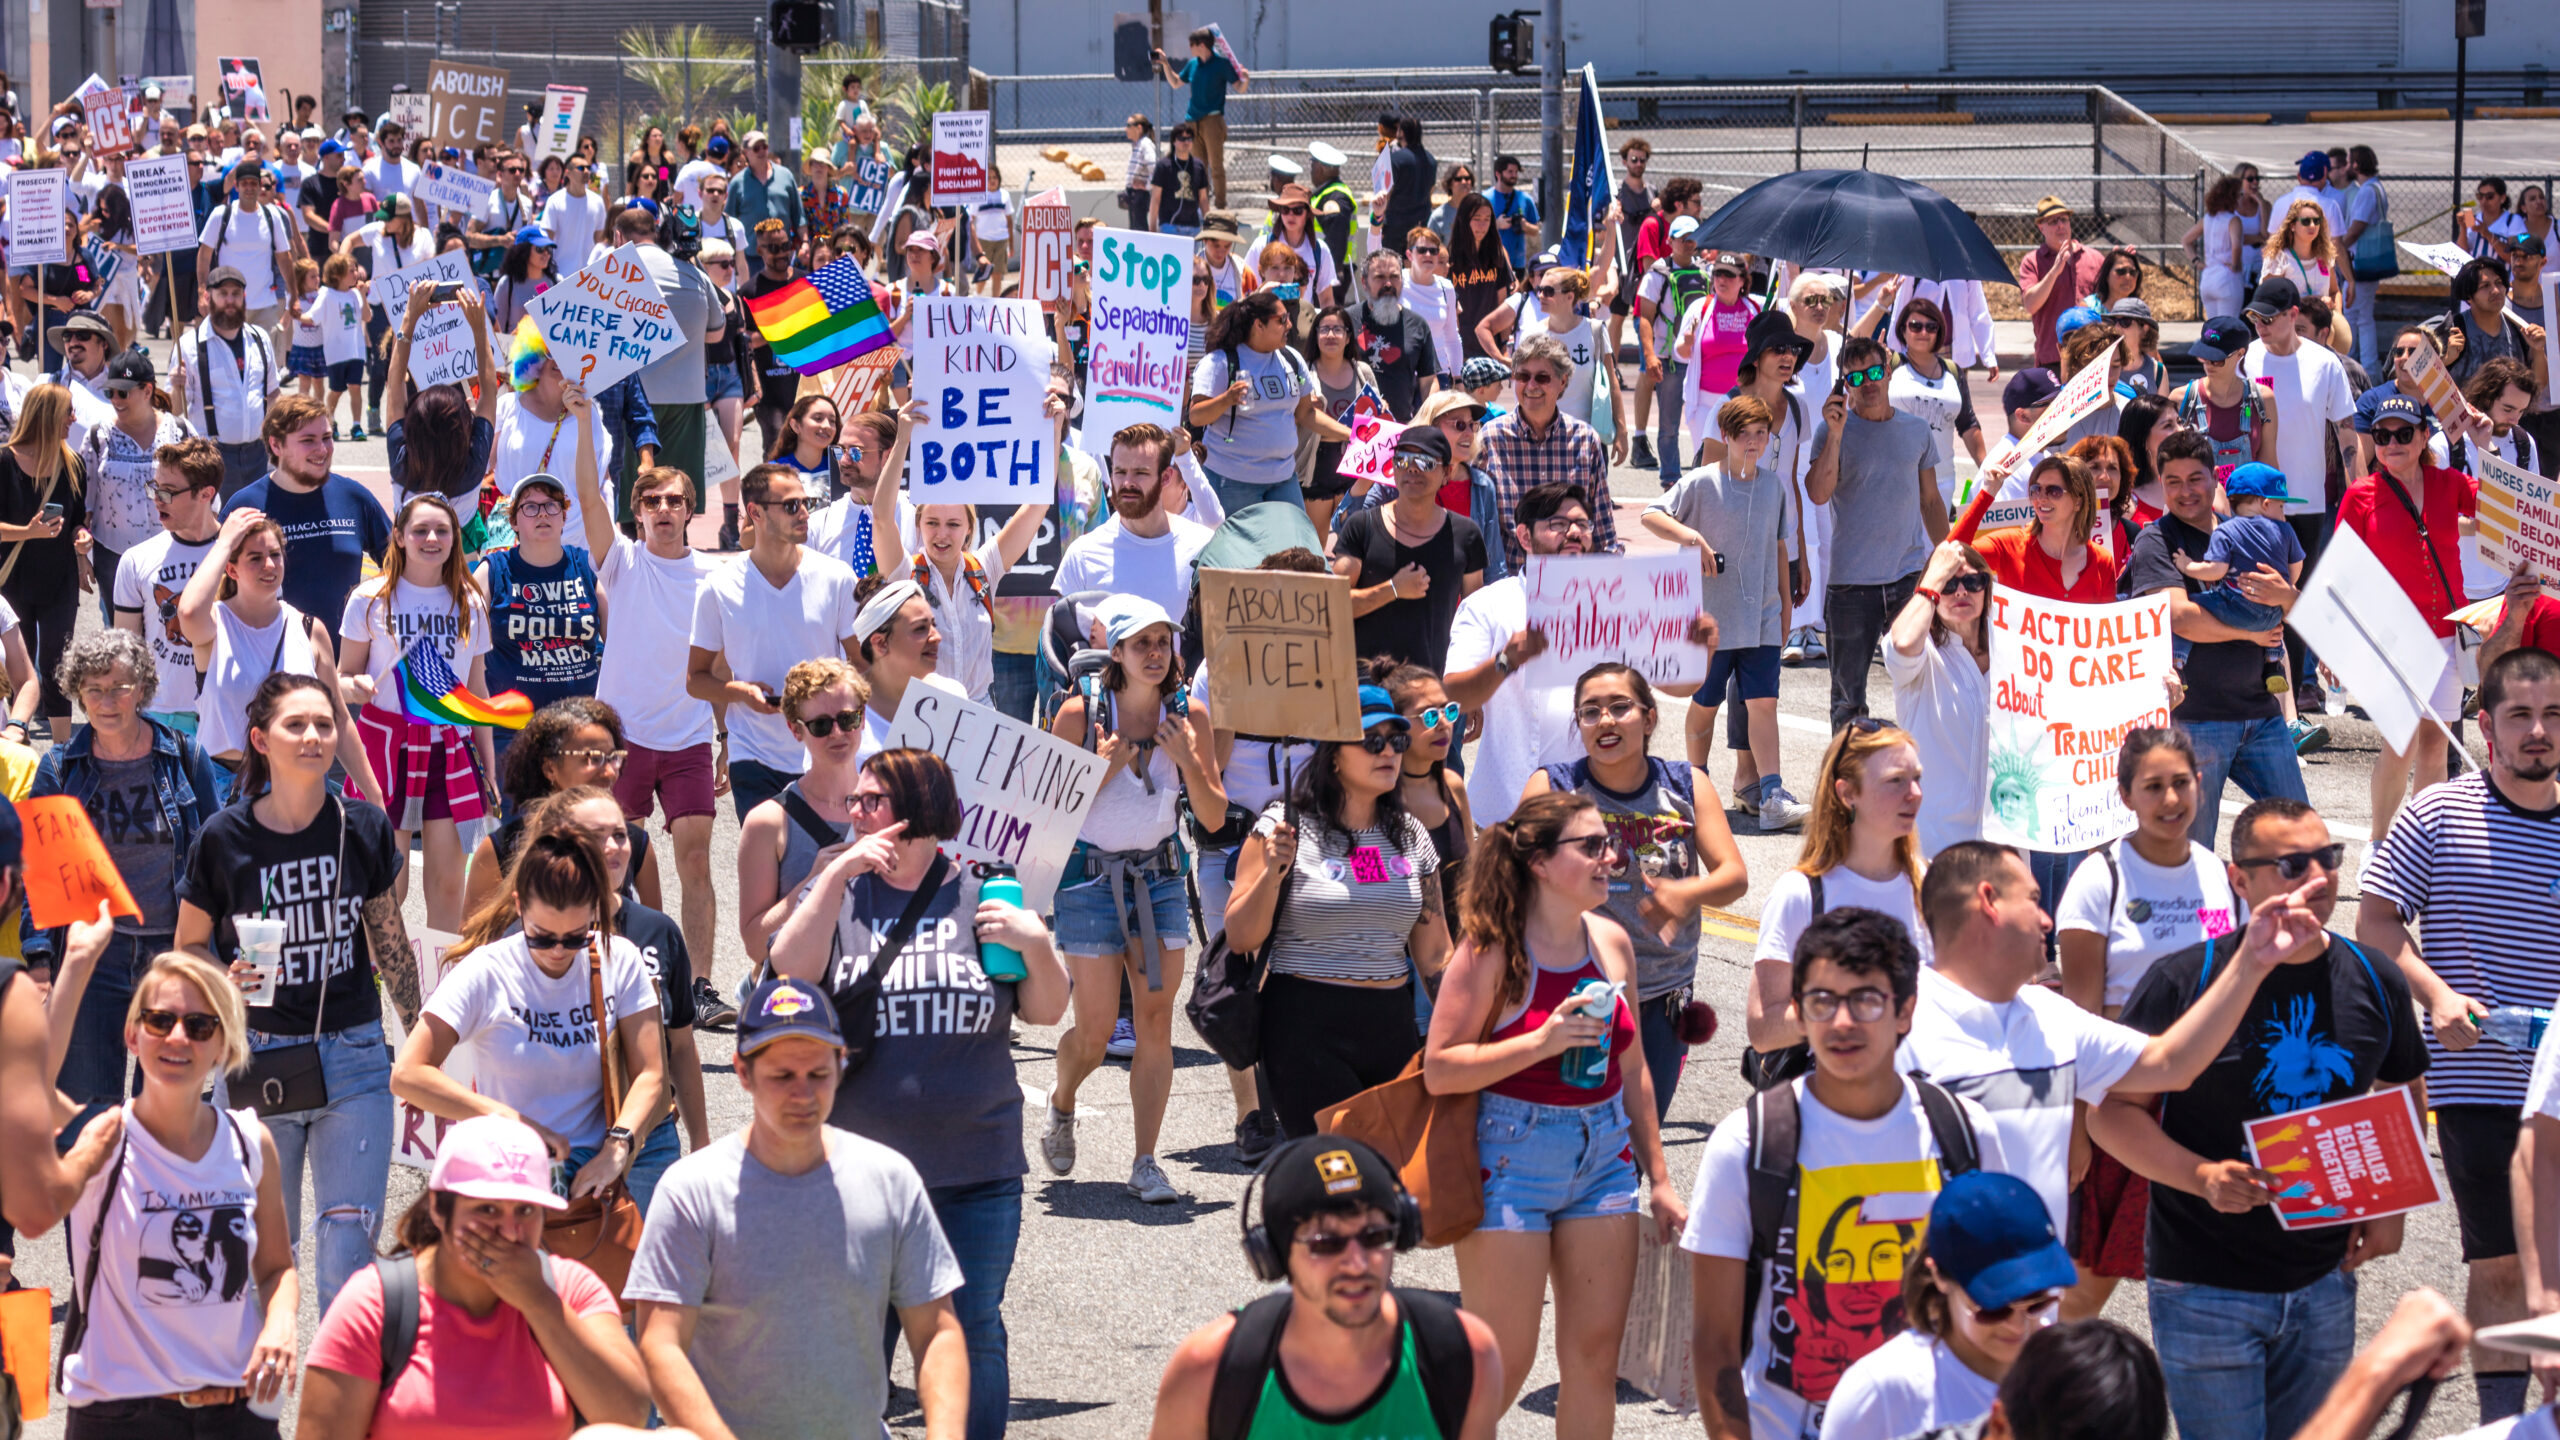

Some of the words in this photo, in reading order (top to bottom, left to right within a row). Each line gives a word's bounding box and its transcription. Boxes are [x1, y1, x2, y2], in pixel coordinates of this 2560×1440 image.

[431, 69, 504, 97] ABOLISH
[85, 90, 122, 109] ABOLISH
[87, 105, 130, 150] ICE
[431, 102, 496, 142] ICE
[939, 120, 972, 128] WORKERS
[958, 130, 983, 138] WORLD
[16, 178, 58, 186] PROSECUTE:
[132, 166, 166, 179] BREAK
[134, 178, 176, 189] DEMOCRATS
[859, 158, 886, 184] ICE
[938, 168, 961, 176] FIGHT
[963, 167, 977, 176] FOR
[938, 180, 982, 190] SOCIALISM!
[135, 186, 184, 198] REPUBLICANS!
[428, 182, 471, 208] CHILDREN
[850, 184, 882, 212] LA!
[138, 211, 188, 224] DEPORTATION
[148, 221, 190, 234] DETENTION
[1026, 206, 1071, 230] ABOLISH
[17, 236, 56, 246] HUMANITY!
[436, 260, 460, 282] be
[604, 254, 645, 283] DID
[1022, 231, 1073, 300] ICE
[1099, 237, 1182, 304] Stop
[576, 270, 614, 300] YOU
[614, 290, 669, 320] CHOOSE
[428, 318, 464, 338] overcome
[542, 298, 622, 331] WHERE
[632, 317, 673, 342] YOU
[928, 304, 1027, 338] HUMAN
[1094, 296, 1189, 350] Separating
[550, 322, 601, 350] CAME
[608, 336, 651, 365] FROM
[944, 344, 1016, 374] KIND
[426, 362, 450, 384] with
[452, 347, 490, 378] GO
[580, 354, 596, 386] ?
[1090, 342, 1184, 394] families!!
[942, 386, 1012, 429] BE
[922, 439, 1040, 486] BOTH
[2482, 459, 2523, 493] NURSES
[2526, 482, 2552, 504] SAY
[282, 522, 318, 534] THACA
[320, 519, 356, 528] COLLEGE
[2516, 498, 2560, 530] FAMILI
[2506, 535, 2560, 572] TOGETHE
[1527, 556, 1626, 606] Love
[527, 603, 544, 614] TO
[552, 602, 579, 614] THE
[1226, 587, 1330, 628] ABOLISH
[1994, 596, 2009, 630] I
[2020, 604, 2167, 649] ACTUALLY
[386, 614, 466, 636] GILMOR
[508, 614, 595, 640] POLLS
[520, 645, 590, 666] MARCH
[1244, 640, 1324, 689] ICE!
[2022, 645, 2053, 683] DO
[2070, 649, 2146, 688] CARE
[1996, 674, 2047, 720] about
[901, 696, 1092, 814] SEEKING
[2072, 756, 2118, 786] CHIL
[954, 798, 1032, 866] YLUM
[260, 855, 338, 906] KEEP
[870, 917, 958, 952] KEP
[570, 994, 616, 1026] GOD
[874, 992, 996, 1038] GETHER
[2314, 1128, 2354, 1200] TOGETHER
[2334, 1124, 2368, 1180] BELONG
[2354, 1119, 2392, 1184] FAMILIES
[141, 1190, 216, 1210] ISLAMIC
